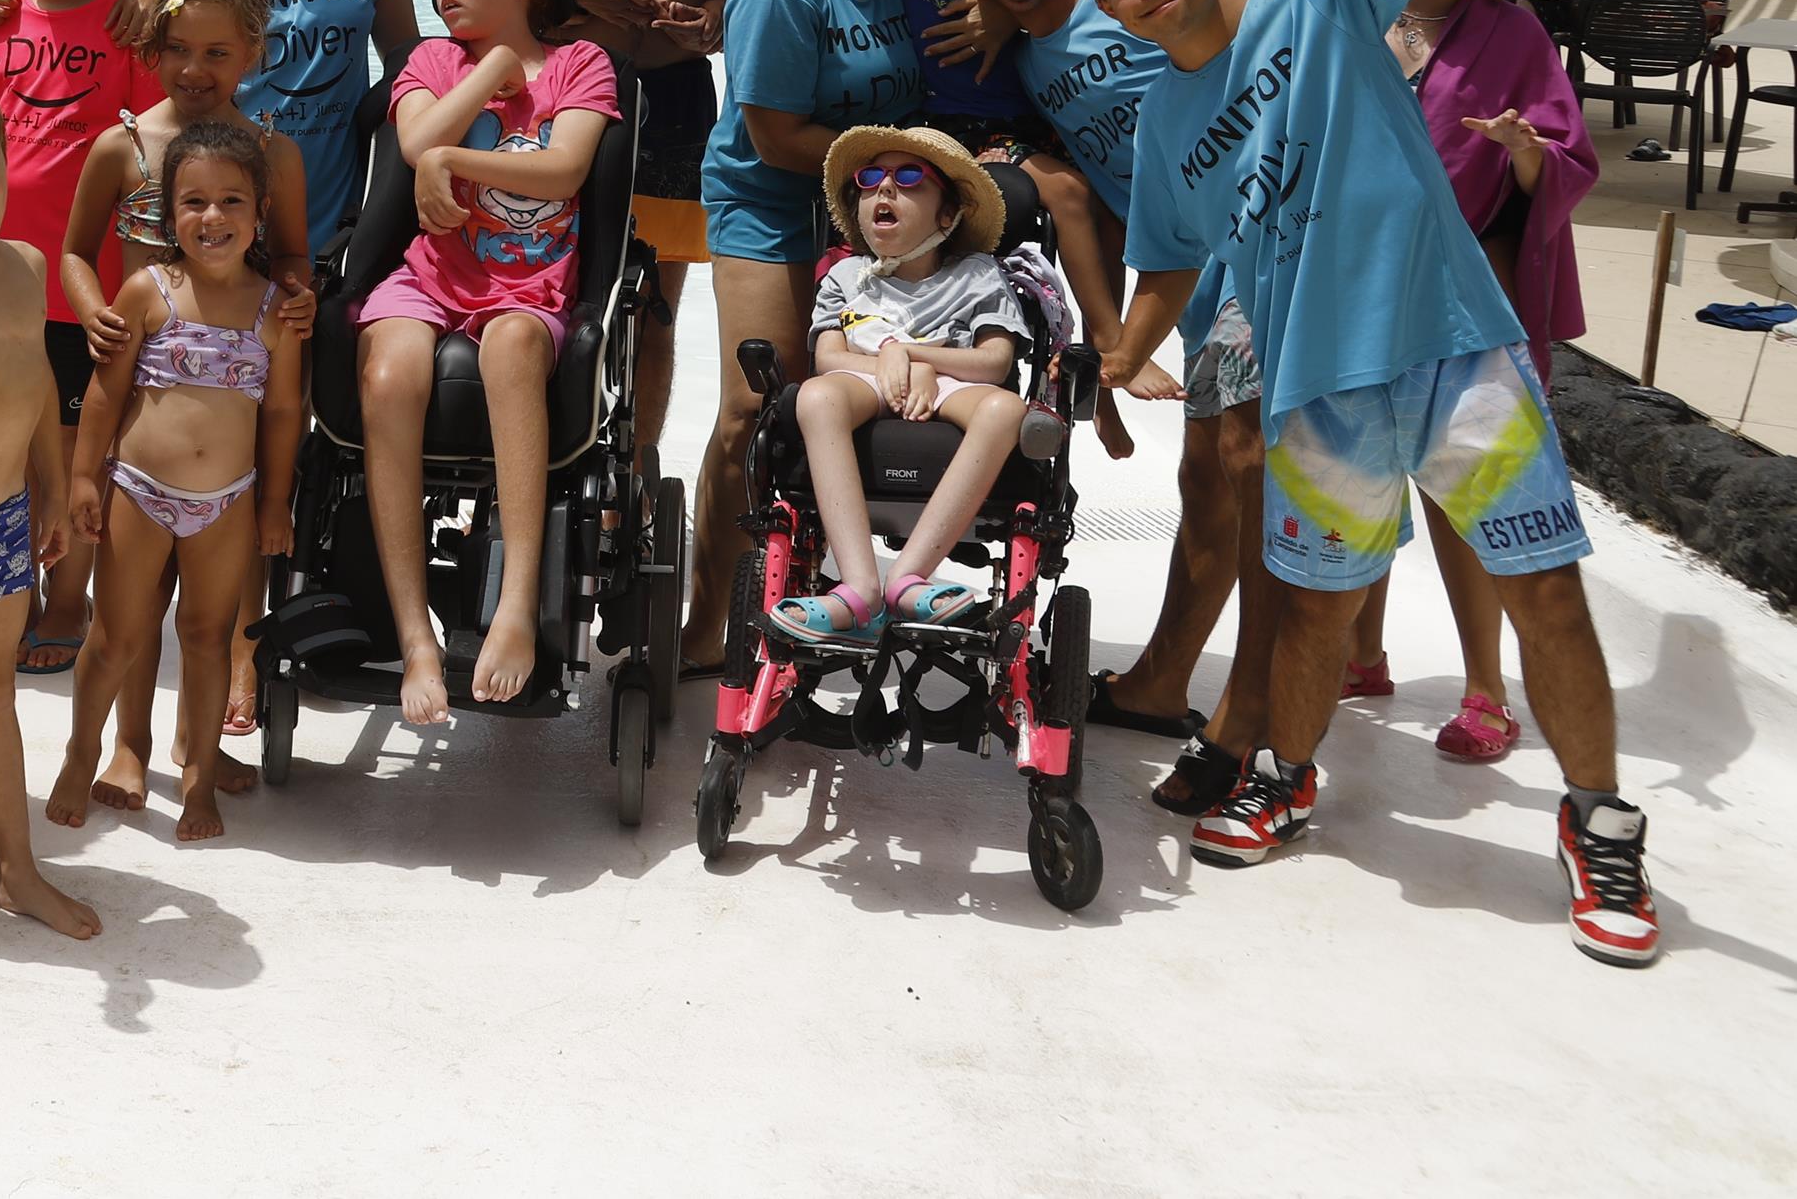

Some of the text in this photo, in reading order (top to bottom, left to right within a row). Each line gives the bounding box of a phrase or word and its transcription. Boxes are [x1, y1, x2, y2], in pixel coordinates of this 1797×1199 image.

[260, 25, 358, 75] Diver
[1073, 97, 1142, 167] Diver
[885, 469, 919, 478] FRONT
[1479, 499, 1581, 550] ESTEBAN
